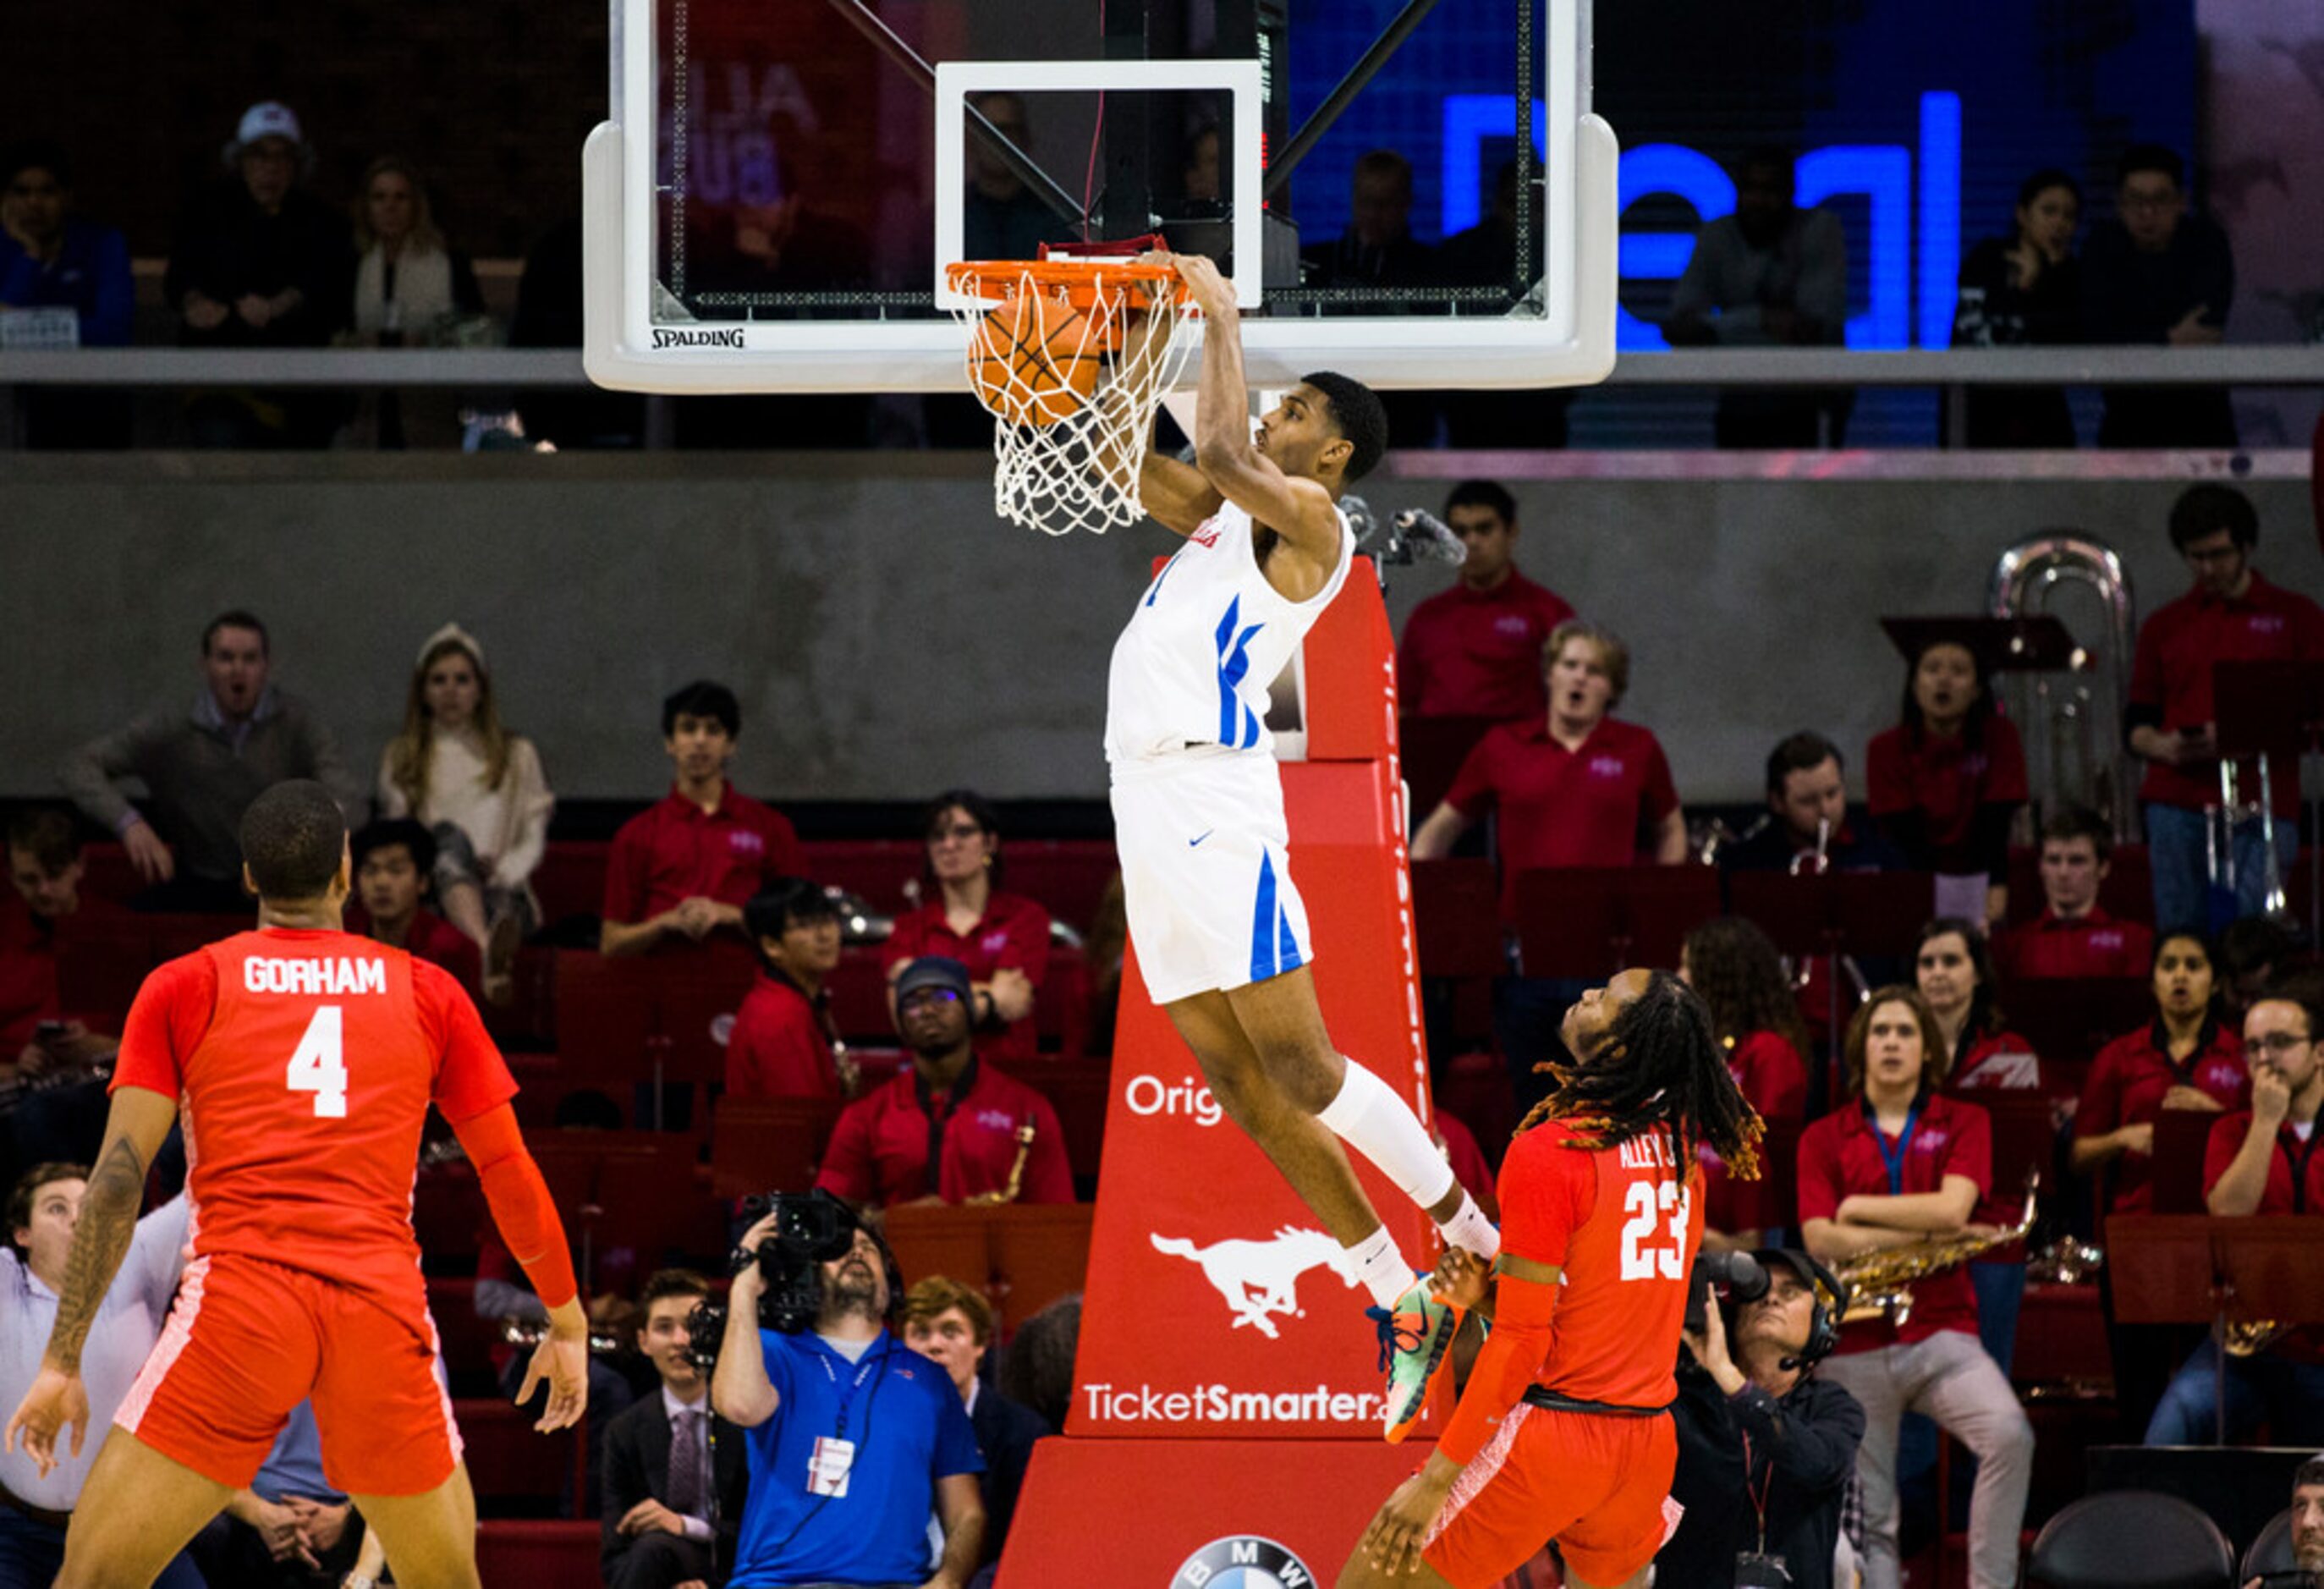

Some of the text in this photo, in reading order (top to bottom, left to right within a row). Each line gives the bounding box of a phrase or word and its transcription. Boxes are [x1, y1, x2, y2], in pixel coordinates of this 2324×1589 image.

[651, 327, 744, 349] SPALDING
[244, 955, 387, 994] GORHAM
[286, 1004, 348, 1118] 4
[1126, 1075, 1222, 1126] Orig
[1619, 1133, 1663, 1168] ALLEY
[1665, 1134, 1677, 1168] J
[1620, 1180, 1690, 1281] 23
[1183, 1541, 1308, 1588] BMW
